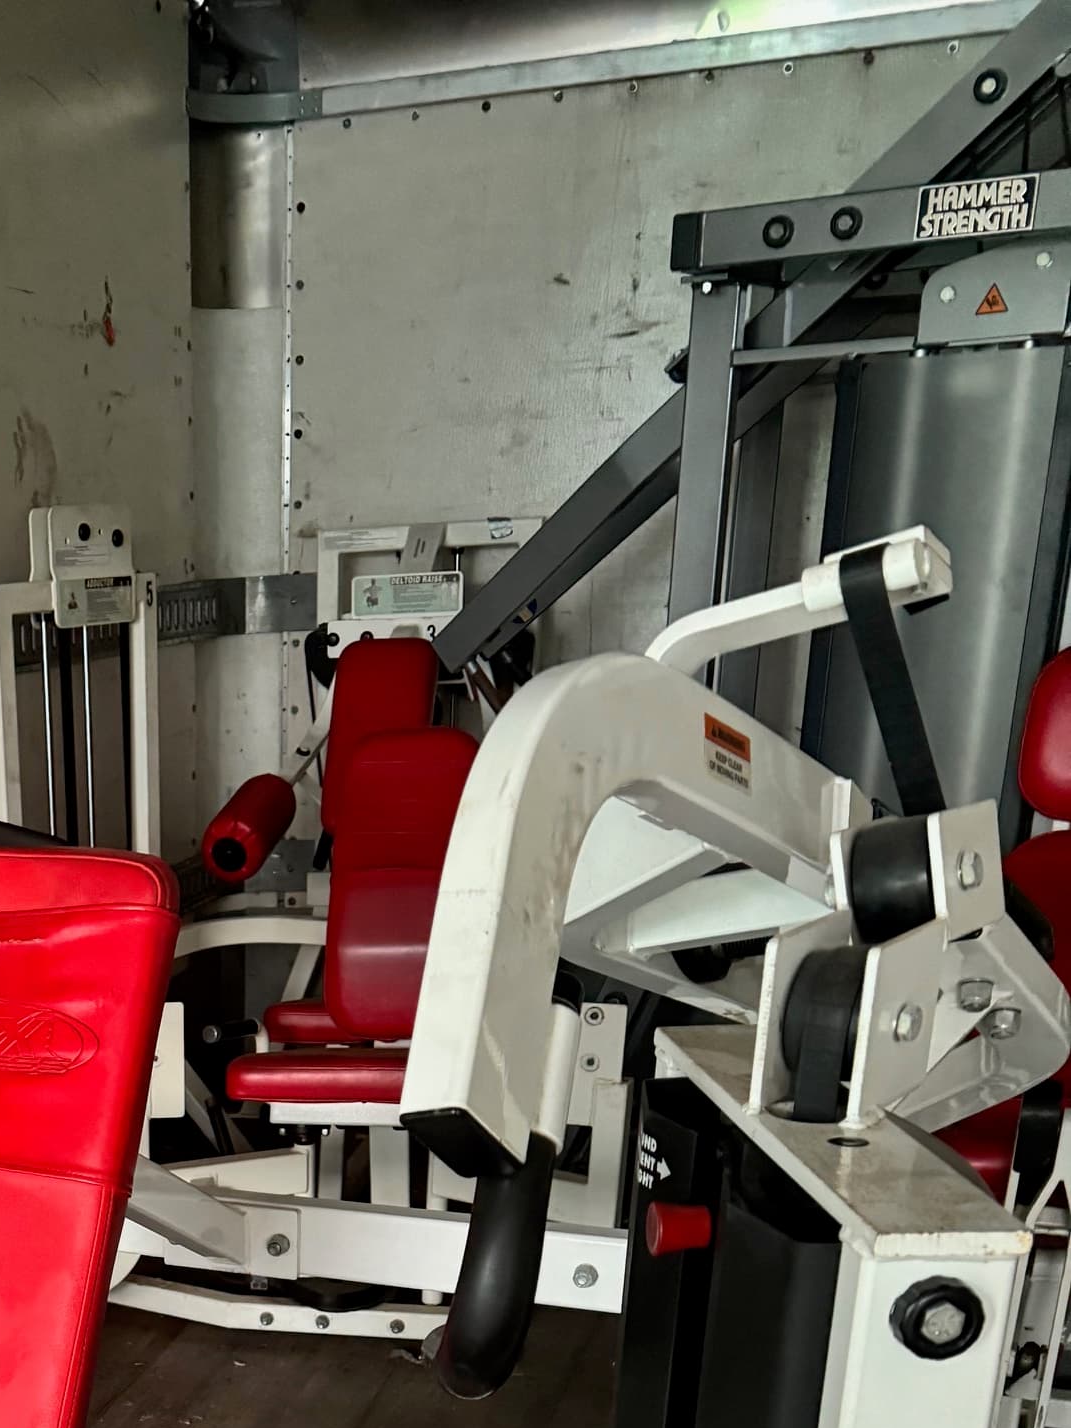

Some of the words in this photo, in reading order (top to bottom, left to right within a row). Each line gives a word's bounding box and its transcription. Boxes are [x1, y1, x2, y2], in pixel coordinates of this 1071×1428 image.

[928, 179, 1027, 211] HAMMER
[919, 203, 1029, 237] STRENGTH
[146, 580, 154, 607] 5
[427, 624, 436, 643] 3
